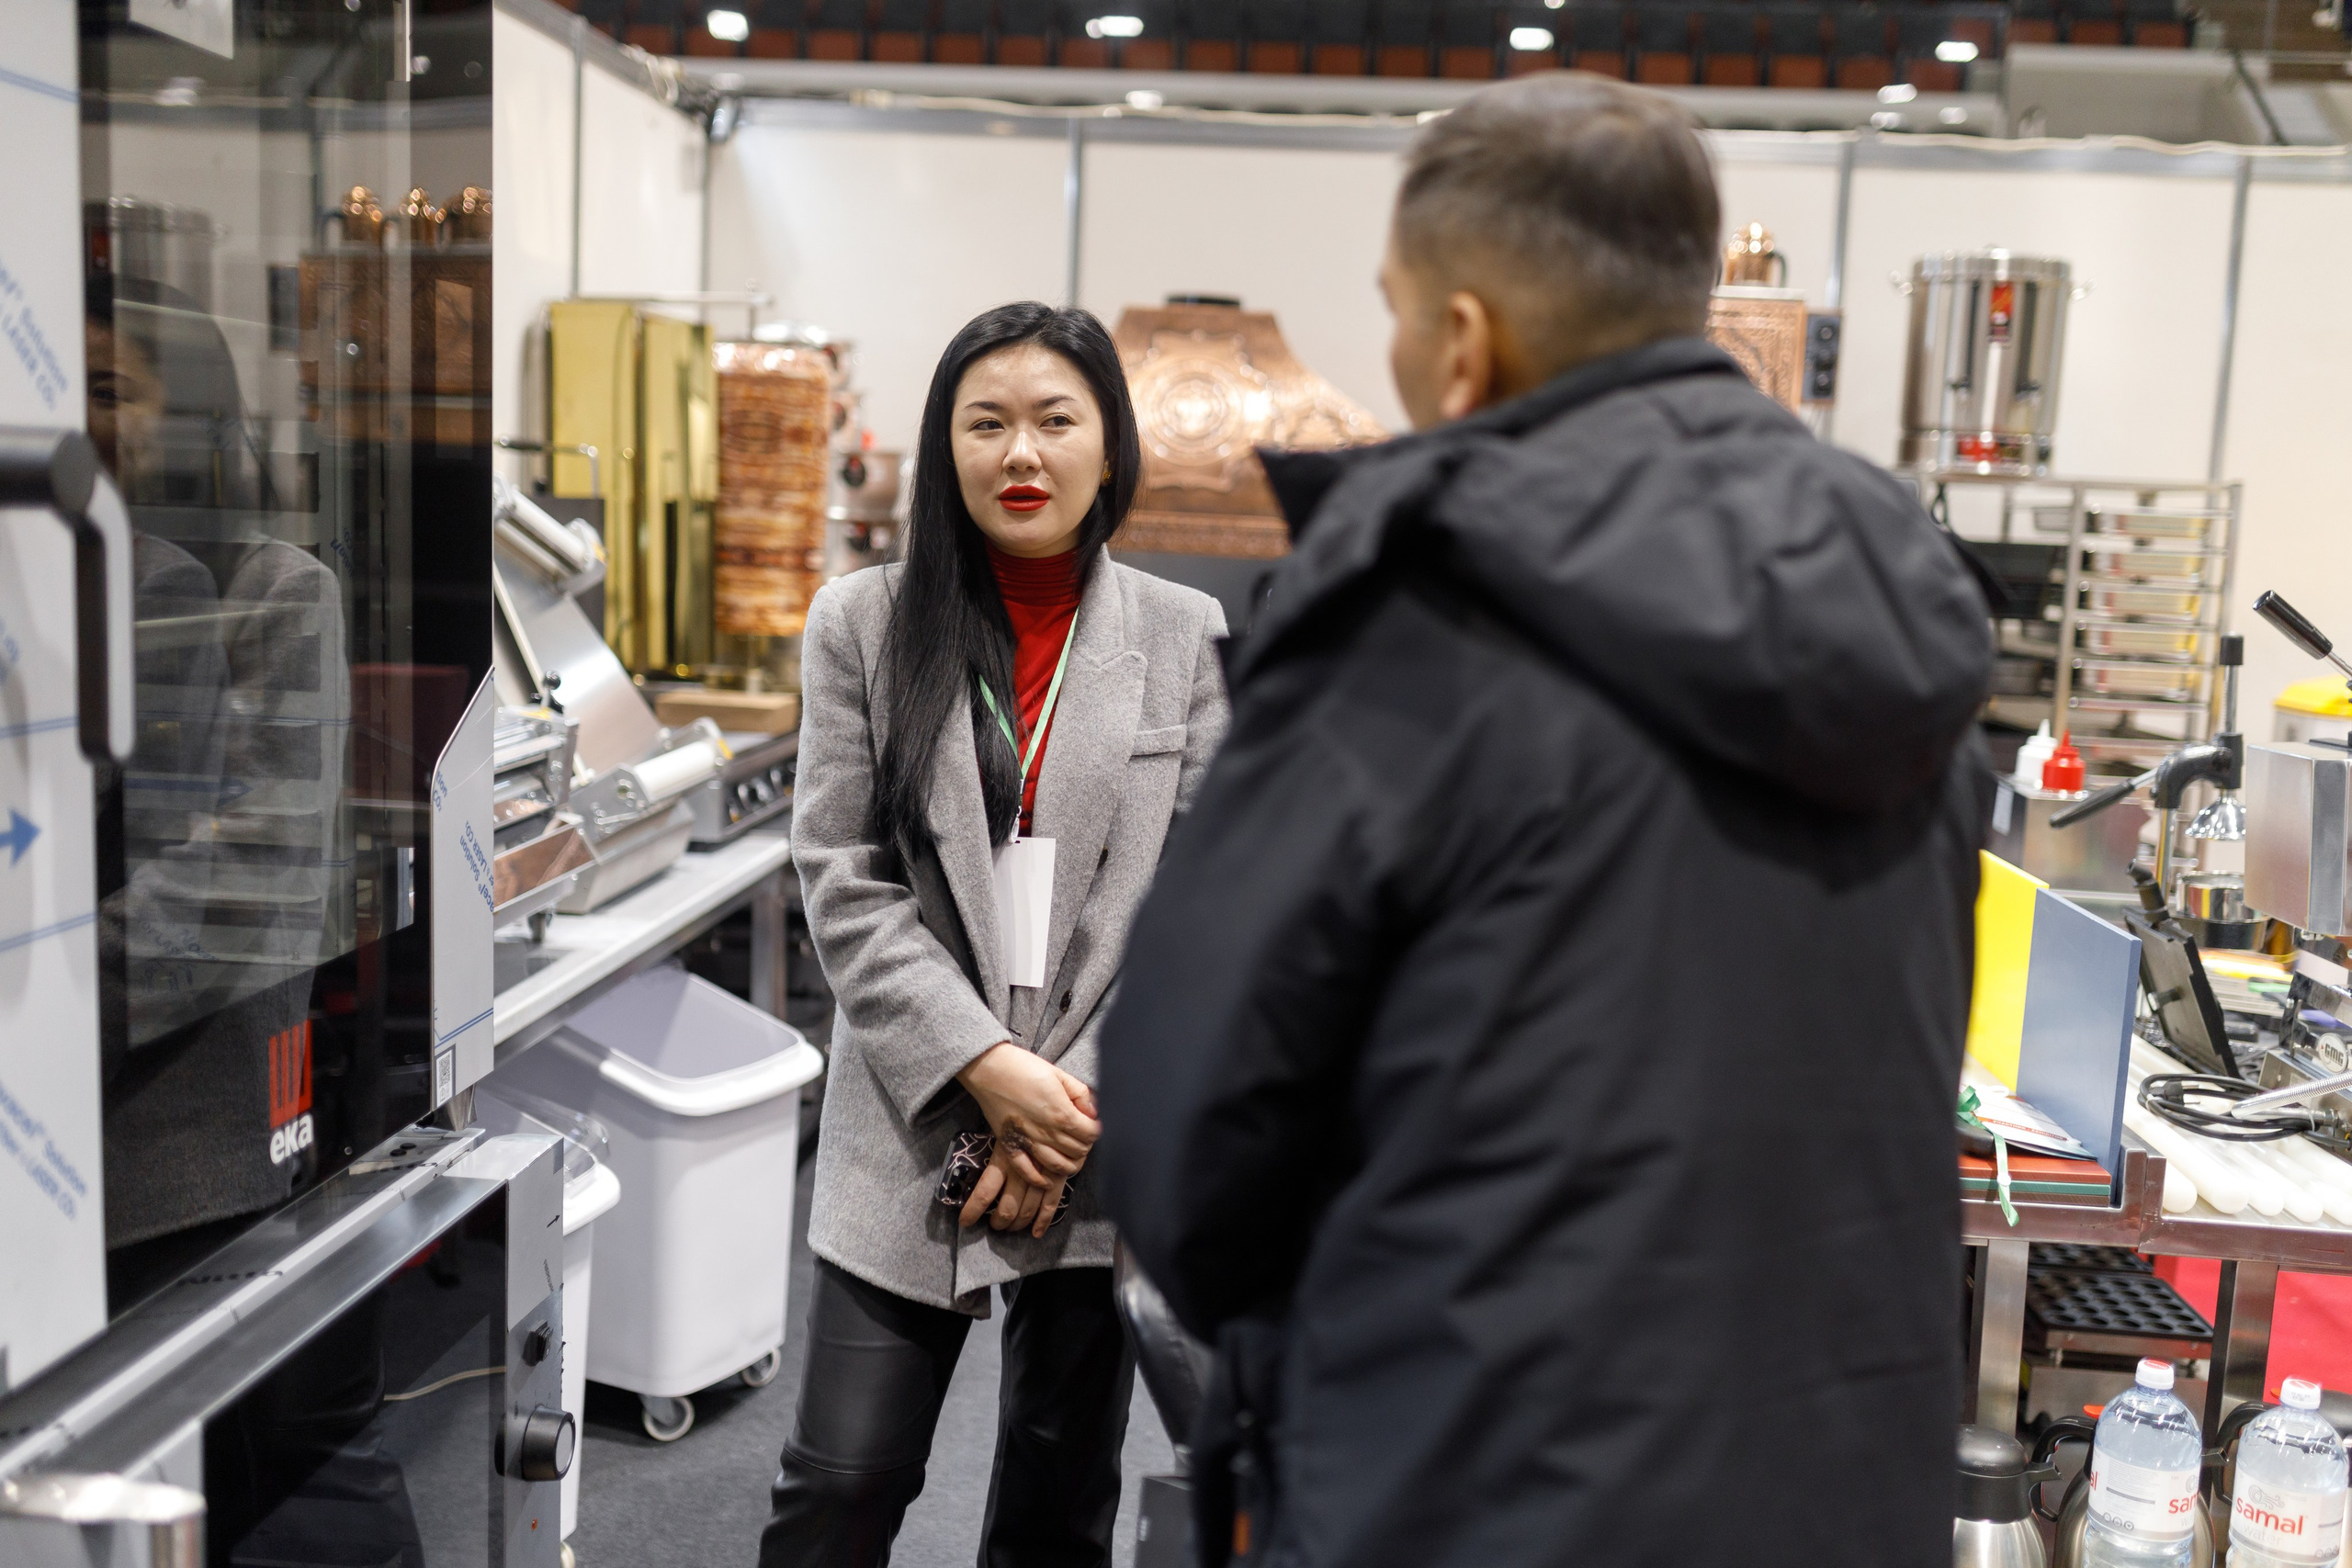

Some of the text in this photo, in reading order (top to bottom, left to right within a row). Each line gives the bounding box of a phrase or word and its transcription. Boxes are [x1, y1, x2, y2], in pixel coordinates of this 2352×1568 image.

[460, 835, 480, 882] Solution
[473, 839, 487, 873] LASER
[2324, 1043, 2344, 1065] GMG
[270, 1111, 314, 1165] eka
[2235, 1497, 2303, 1535] samal
